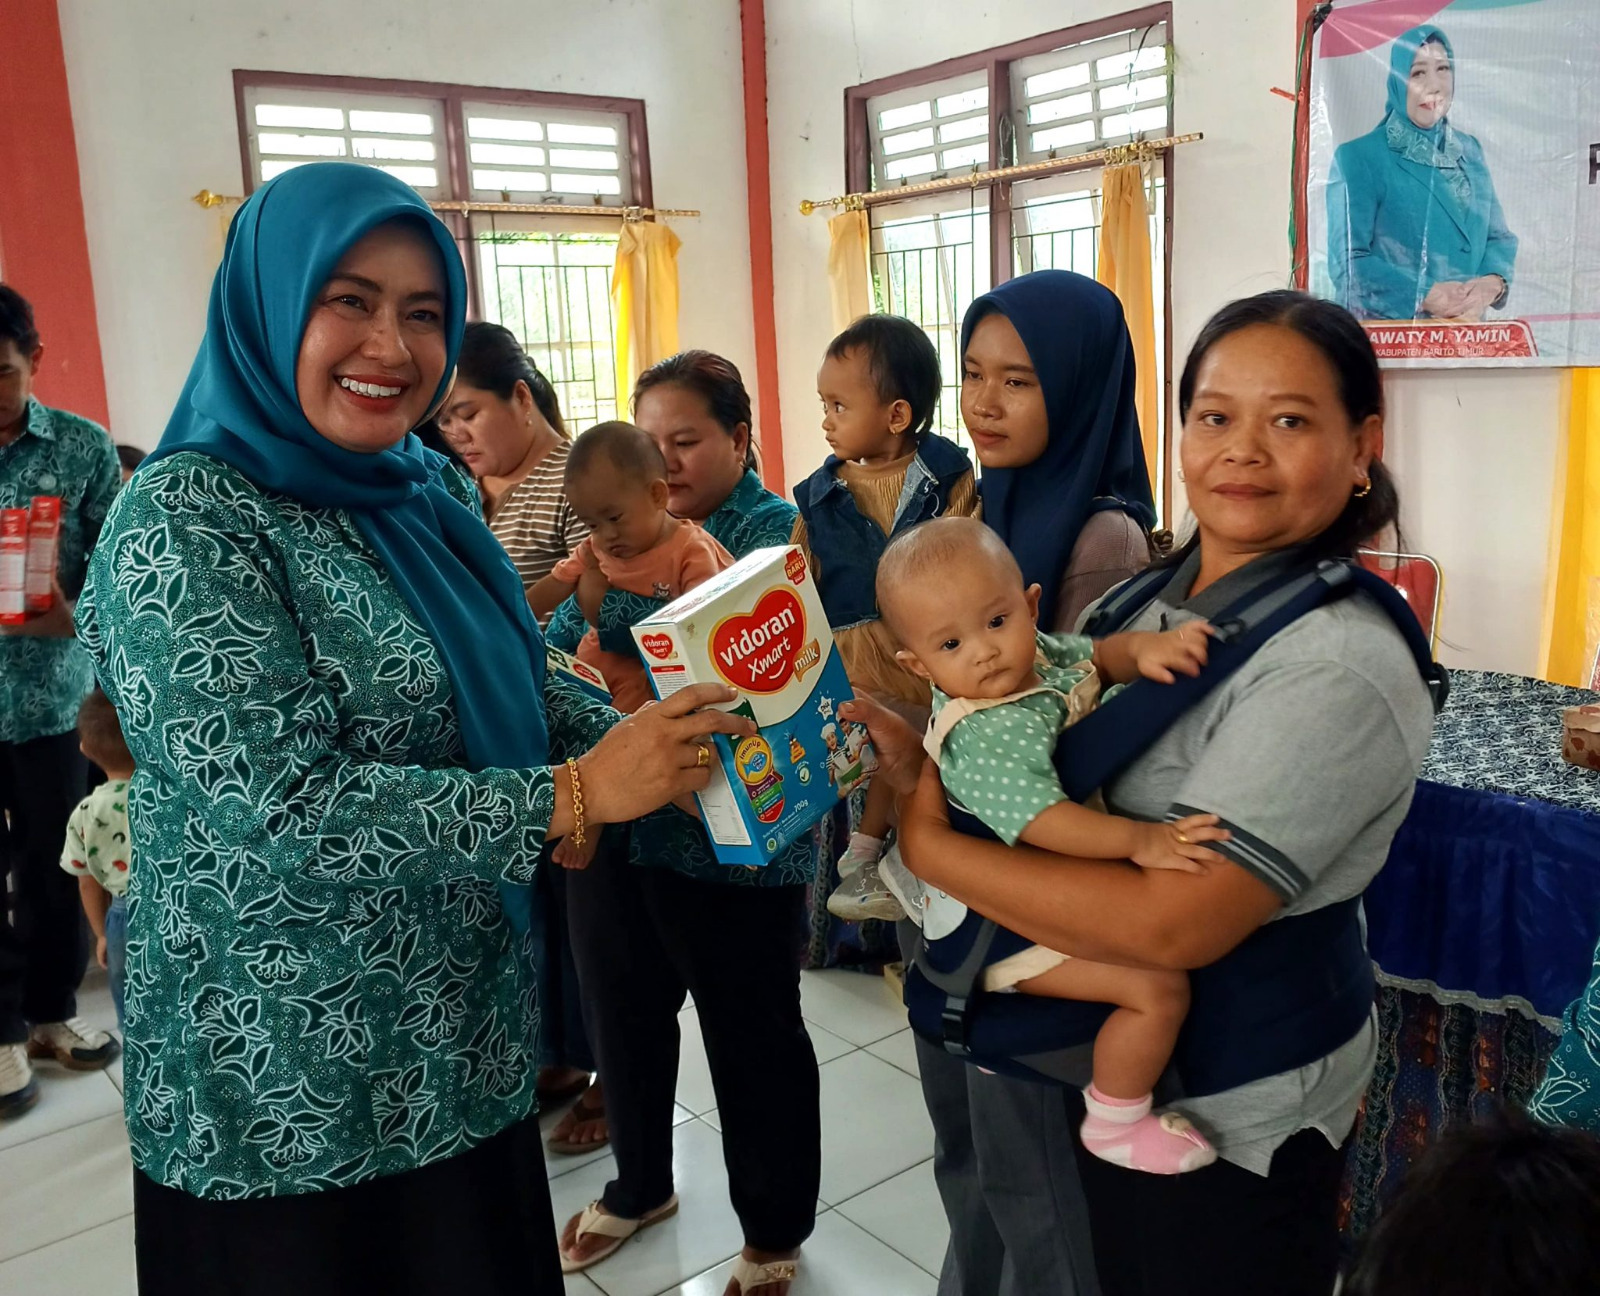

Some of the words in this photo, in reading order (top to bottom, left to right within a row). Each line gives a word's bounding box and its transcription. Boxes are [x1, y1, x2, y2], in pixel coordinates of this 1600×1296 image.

[1430, 331, 1448, 344] M.
[1454, 329, 1511, 344] YAMIN
[1375, 348, 1422, 357] KABUPATEN
[1423, 347, 1455, 356] BARITO
[1458, 346, 1485, 356] TIMUR
[787, 559, 805, 577] BARU
[643, 638, 670, 648] vidoran
[720, 607, 796, 667] vidoran
[747, 636, 791, 682] Xmart
[794, 645, 819, 672] milk
[794, 799, 809, 813] 700g
